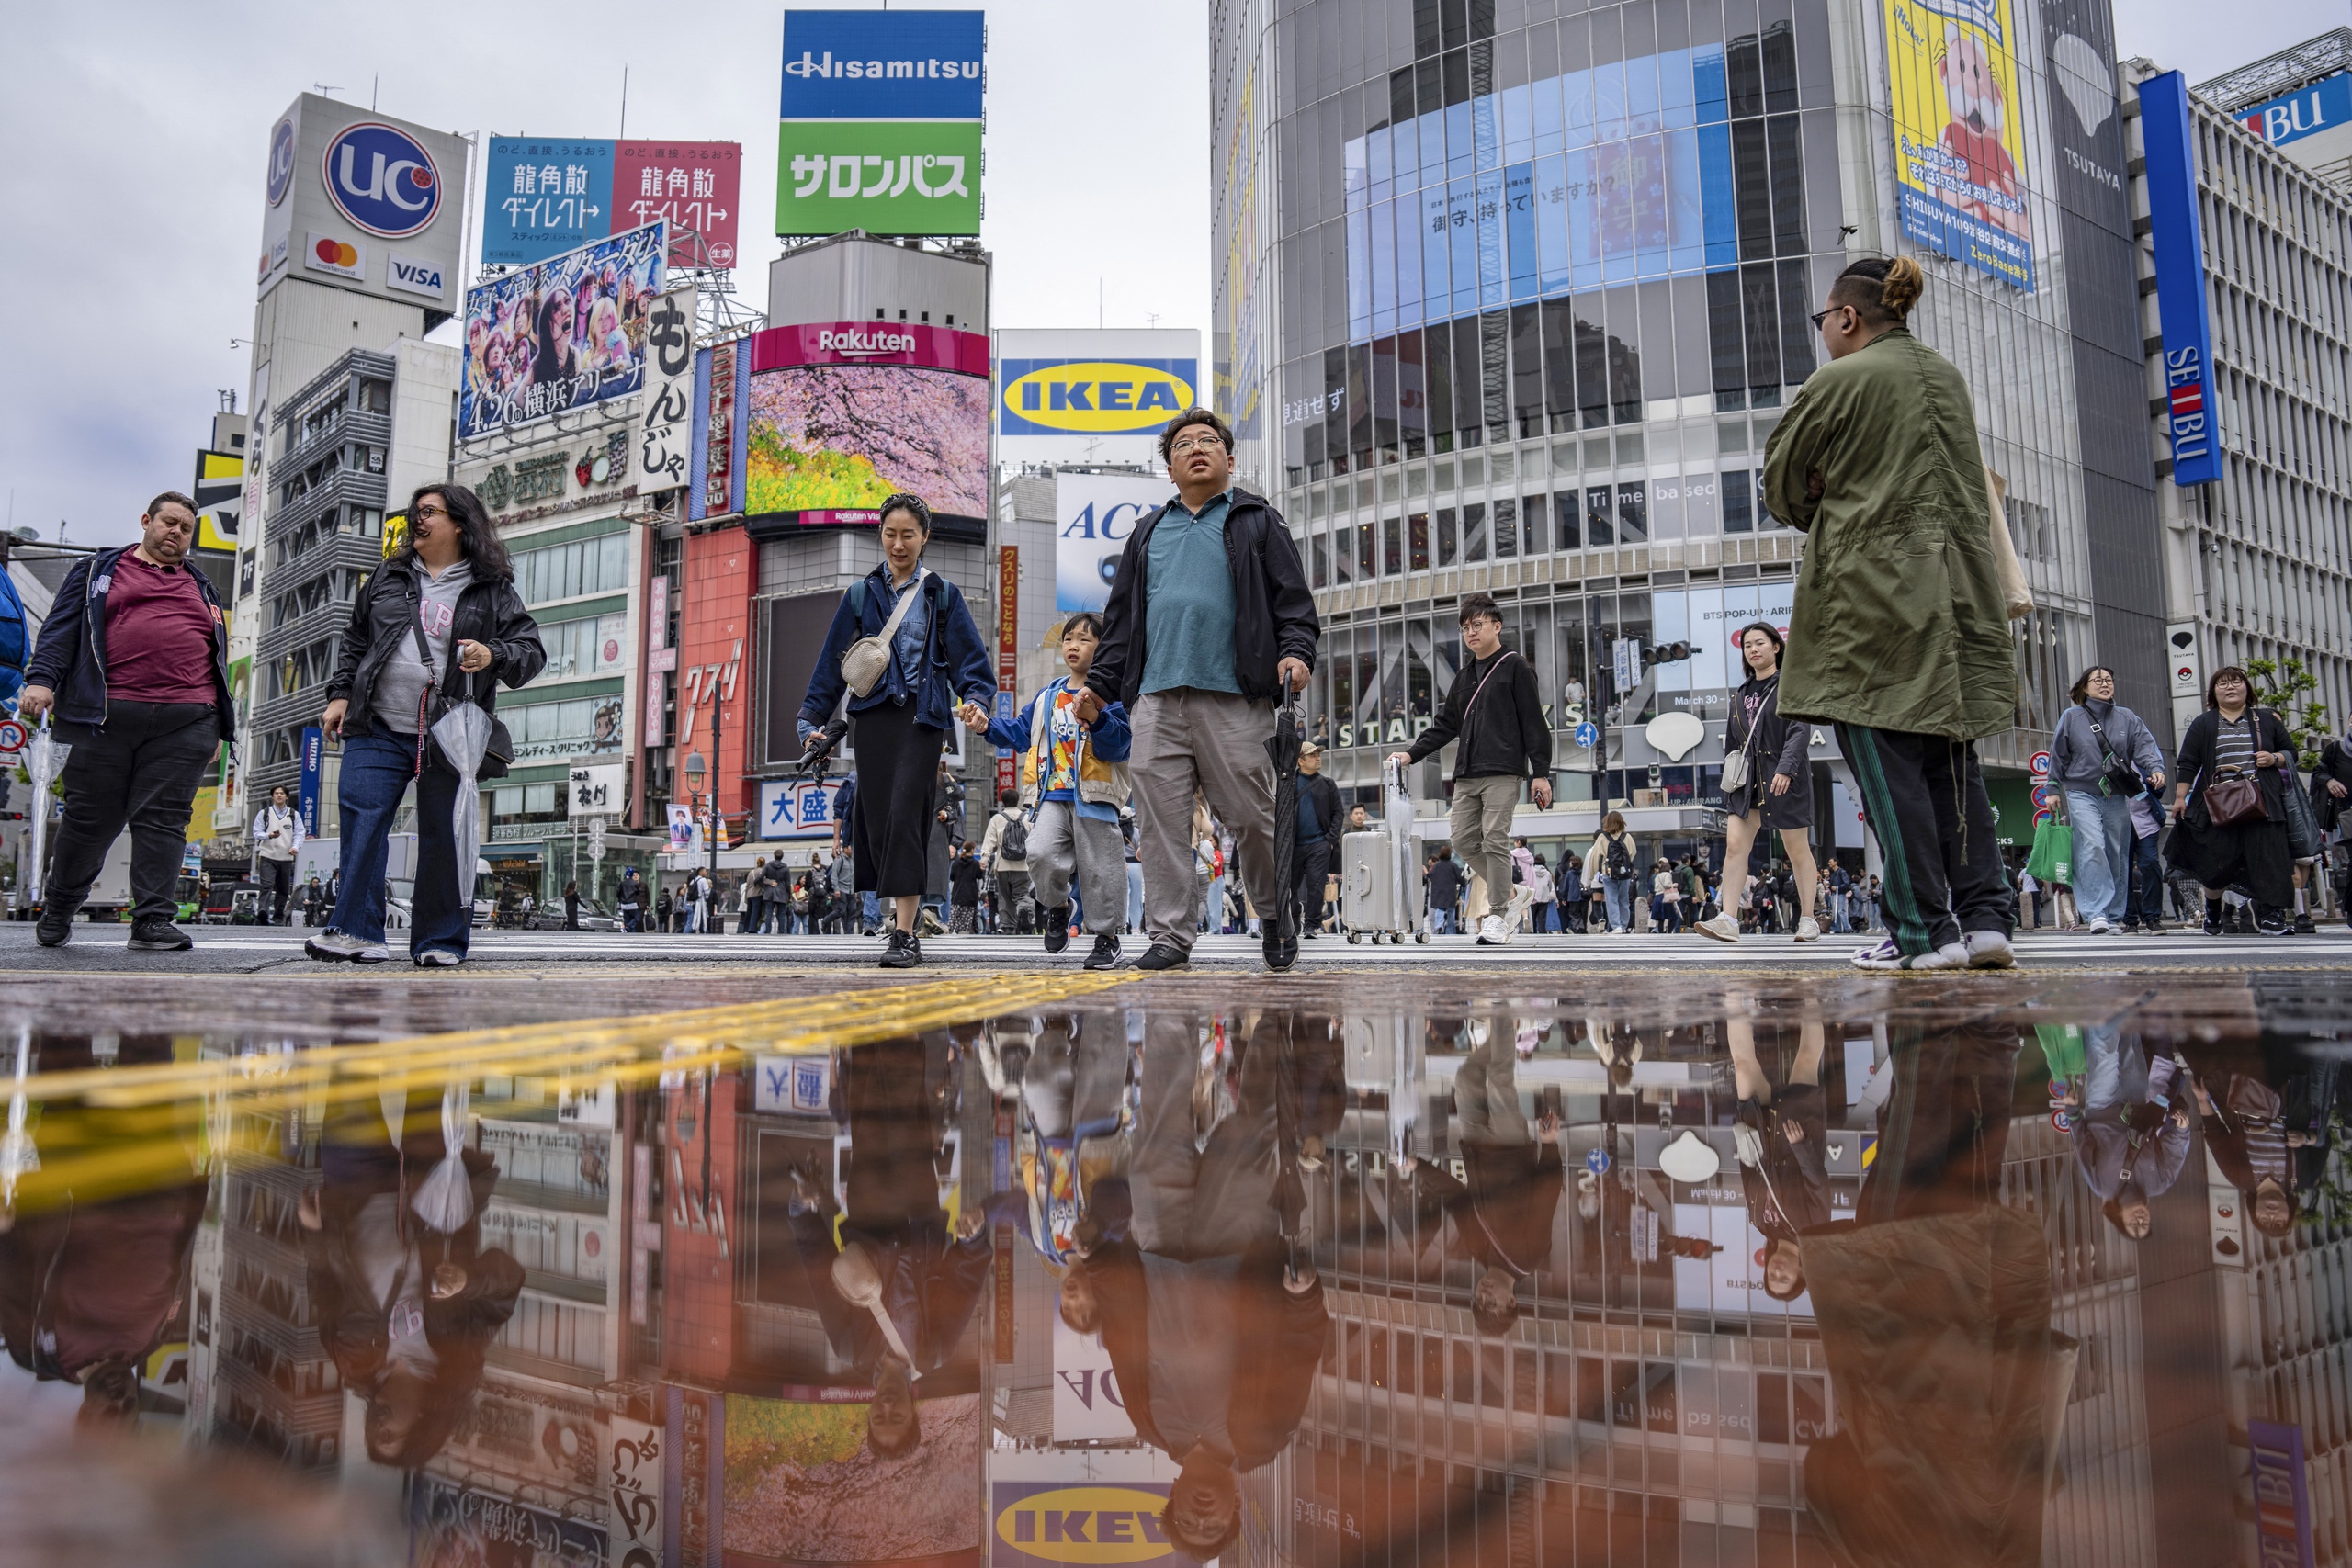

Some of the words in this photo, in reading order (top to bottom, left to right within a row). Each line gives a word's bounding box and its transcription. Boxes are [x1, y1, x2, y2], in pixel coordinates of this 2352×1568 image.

[785, 51, 980, 80] Hisamitsu
[497, 145, 607, 157] のど、直接、うるおう
[624, 147, 734, 161] のど、直接、うるおう
[514, 164, 588, 195] 龍角散
[640, 166, 716, 198] 龍角散
[790, 154, 968, 199] サロンパス
[2064, 147, 2121, 192] TSUTAYA
[511, 232, 549, 242] スティック
[316, 263, 356, 276] mastercard
[392, 262, 442, 289] VISA
[820, 330, 916, 355] Rakuten
[524, 357, 645, 420] 横浜アリーナ
[644, 296, 690, 482] もんじゃ
[1022, 381, 1182, 411] IKEA
[2167, 345, 2208, 463] SEIBU
[1589, 490, 1644, 507] Time
[1657, 479, 1716, 501] based
[835, 512, 866, 520] Rakuten
[243, 562, 254, 581] 7F
[1003, 550, 1014, 645] クスリのことなら
[1703, 611, 1723, 621] BTS
[1724, 608, 1764, 619] POP-UP
[1674, 695, 1704, 705] March
[1705, 694, 1718, 704] 30
[309, 737, 319, 772] MIZUHO
[771, 790, 828, 825] 大盛
